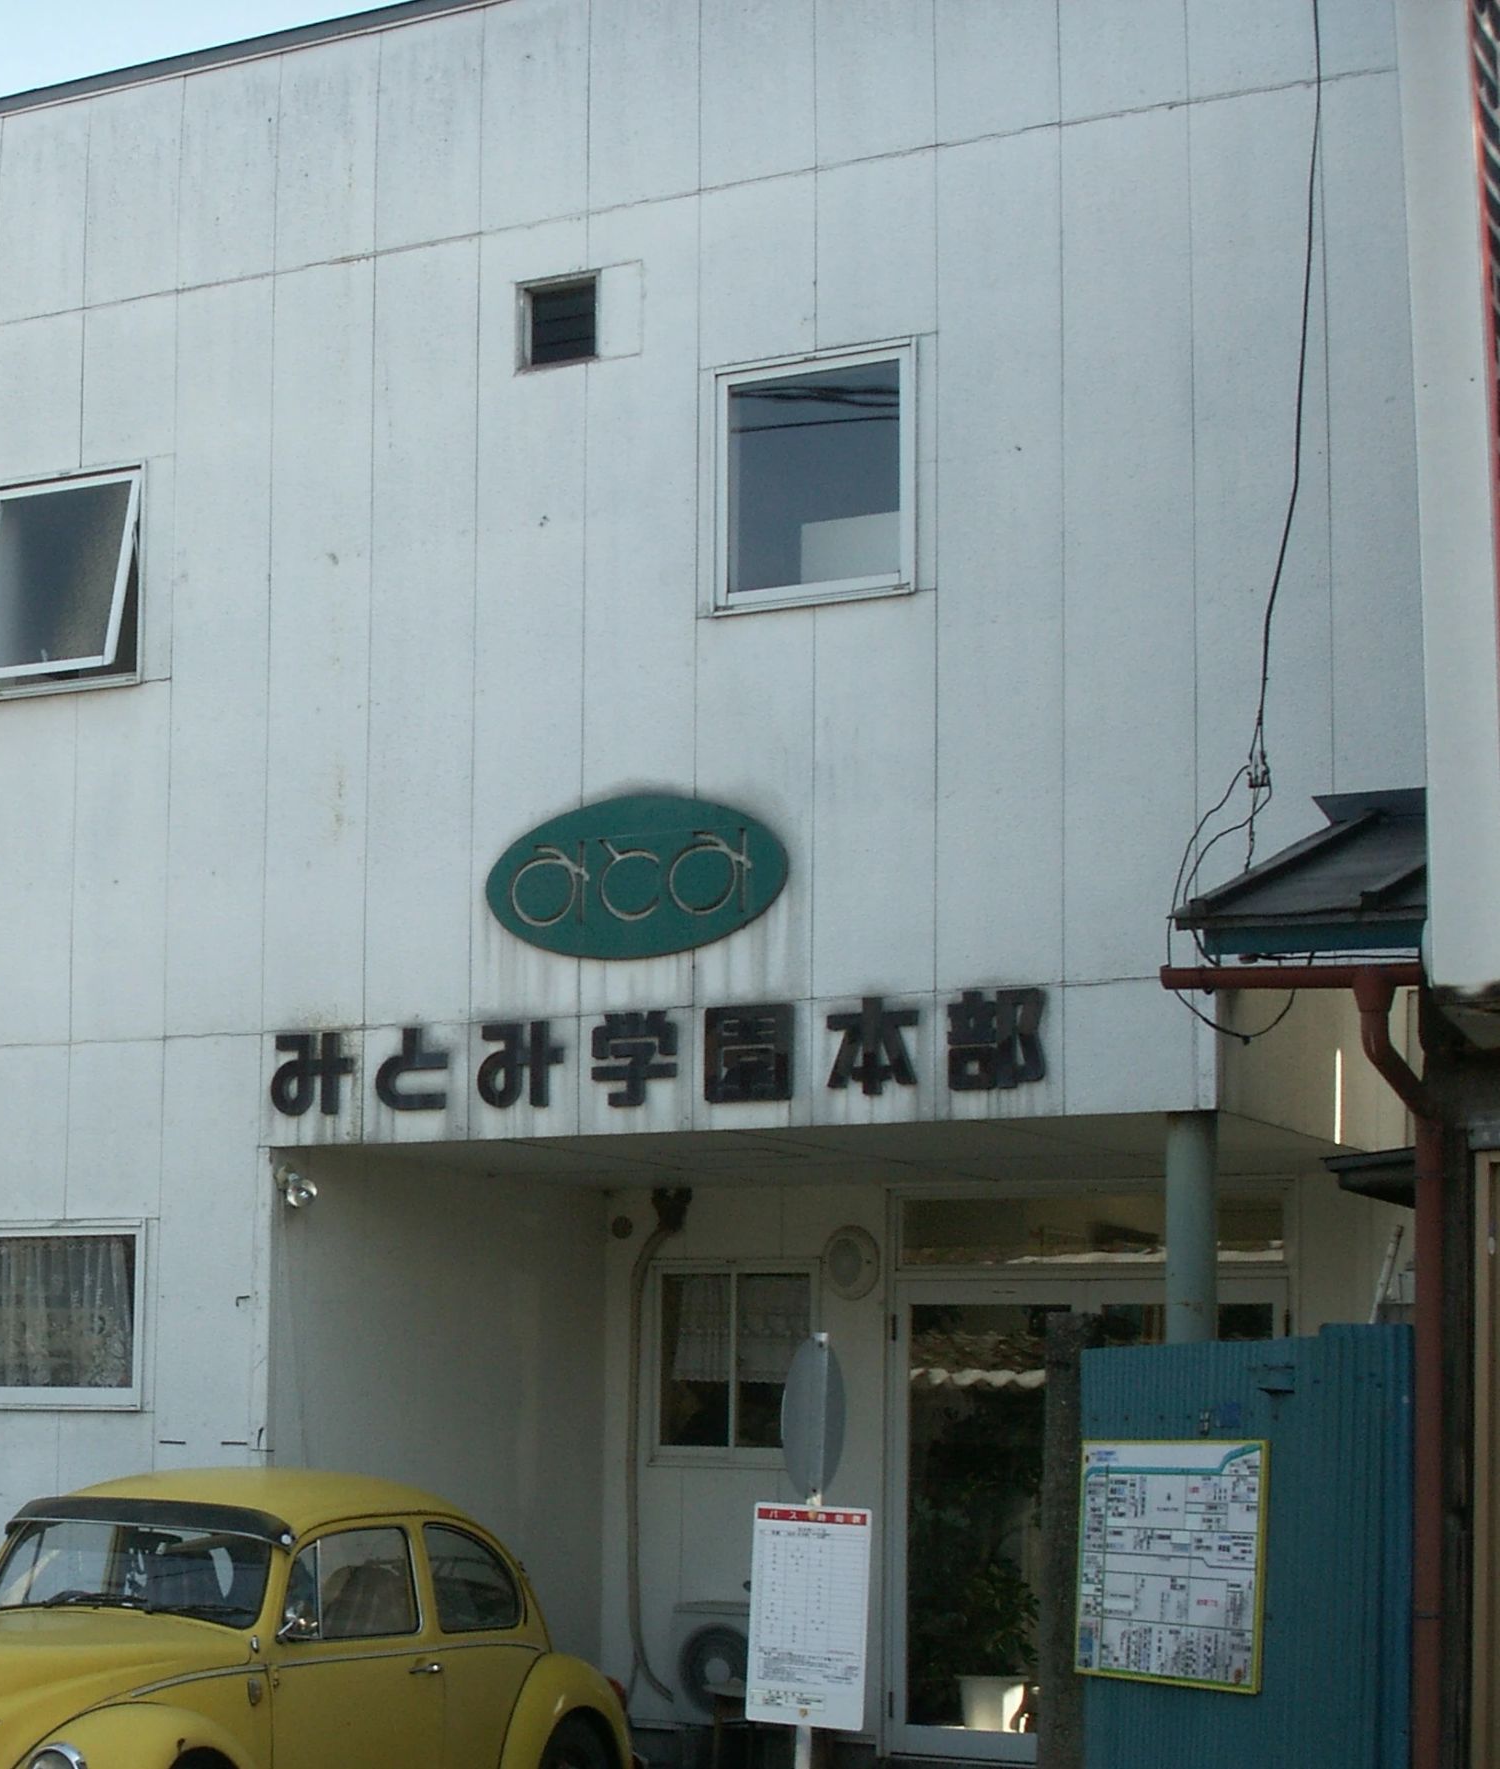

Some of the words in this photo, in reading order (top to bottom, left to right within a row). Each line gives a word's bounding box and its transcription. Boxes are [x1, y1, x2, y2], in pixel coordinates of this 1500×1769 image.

[270, 987, 1047, 1116] みとみ学園本部
